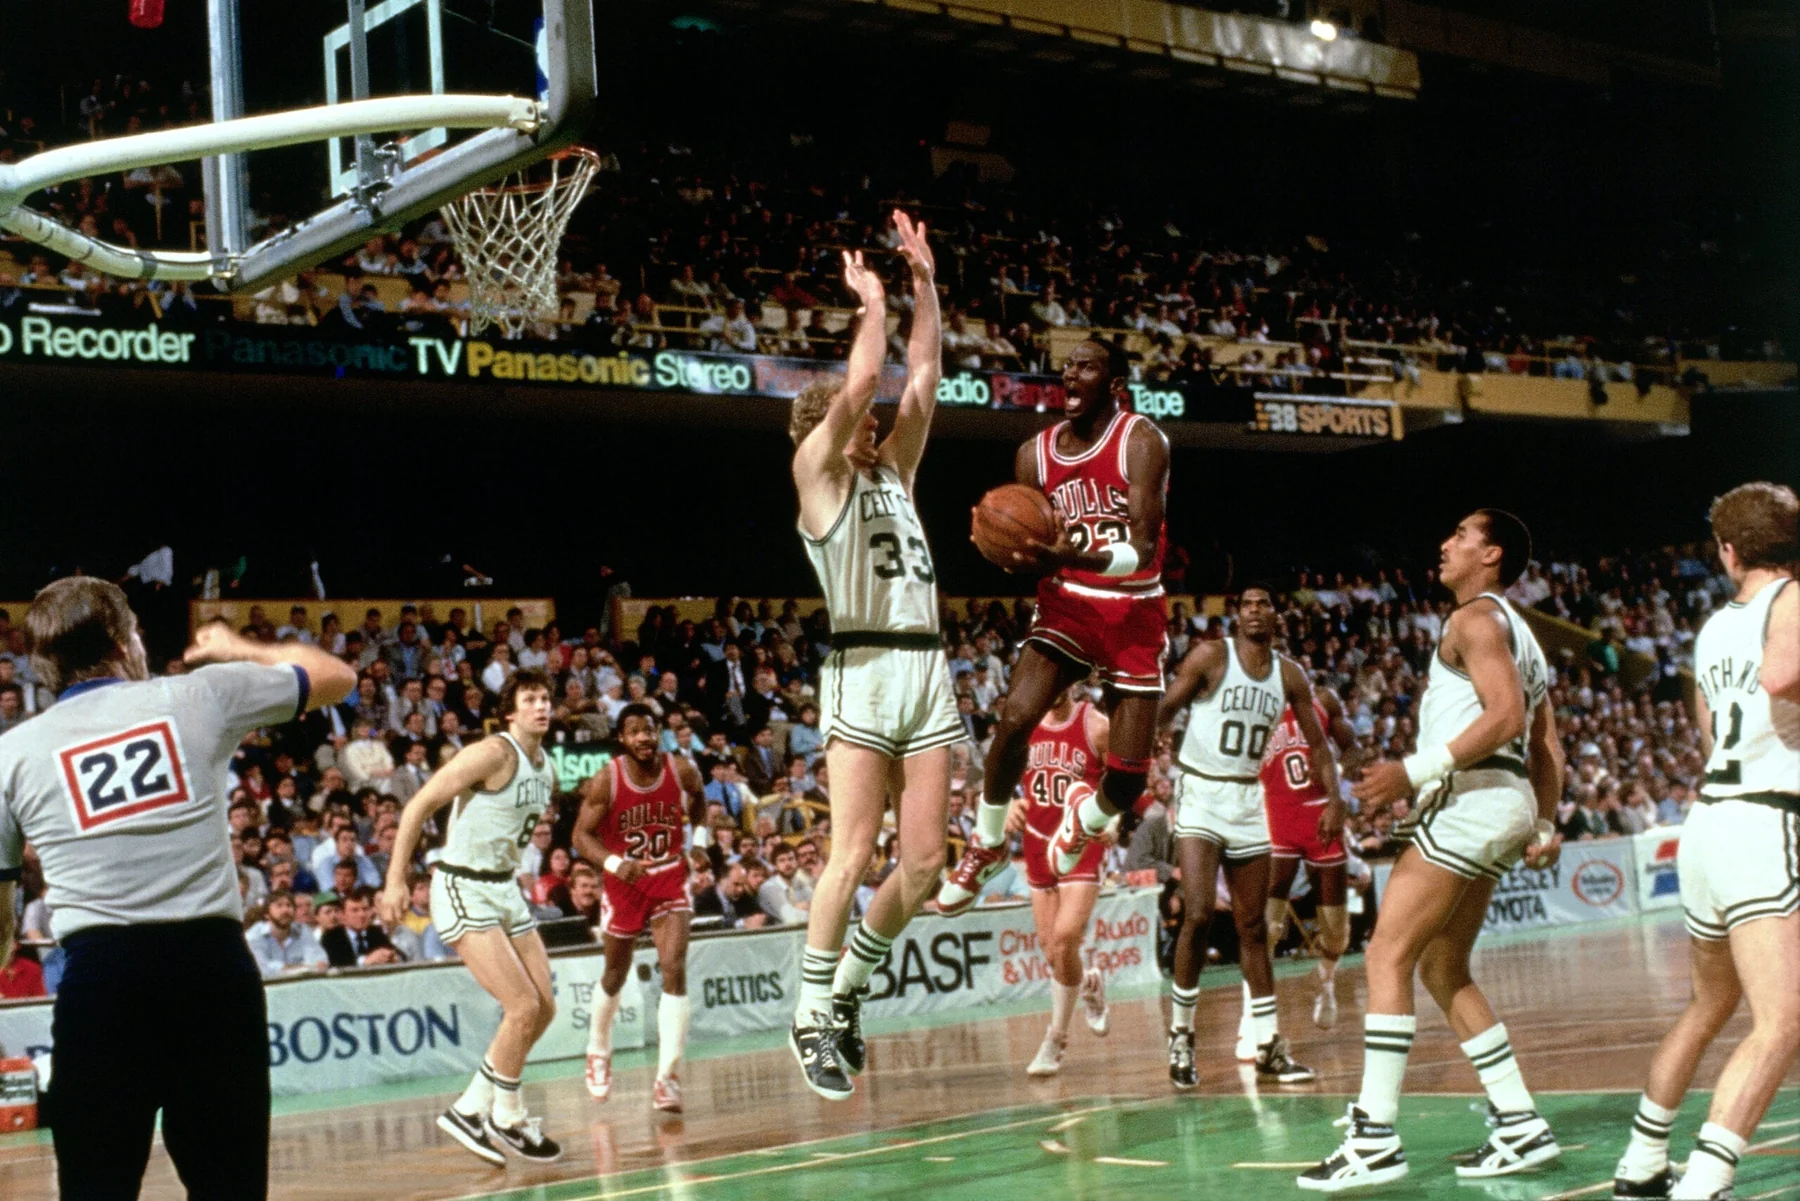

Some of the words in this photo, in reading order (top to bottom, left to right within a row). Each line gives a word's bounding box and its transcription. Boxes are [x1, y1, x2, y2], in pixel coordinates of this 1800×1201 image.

[21, 316, 196, 362] Recorder
[408, 337, 462, 376] TV
[467, 341, 650, 387] Panasonic
[655, 353, 751, 391] Stereo
[935, 371, 990, 405] adio
[1128, 383, 1184, 419] Tape
[1299, 404, 1389, 436] SPORTS
[869, 532, 934, 585] 33
[1221, 684, 1279, 722] CELTICS
[1219, 719, 1270, 760] 00
[79, 738, 170, 811] 22
[552, 745, 610, 780] lson
[1282, 751, 1312, 790] 0
[1031, 770, 1075, 807] 40
[618, 800, 678, 833] BULLS
[624, 828, 672, 861] 20
[1096, 911, 1148, 942] Audio
[1484, 895, 1548, 925] OYOTA
[868, 931, 994, 1001] BASF
[1003, 960, 1020, 985] &
[1085, 946, 1142, 976] Tapes
[703, 970, 785, 1009] CELTICS
[268, 1003, 461, 1067] BOSTON
